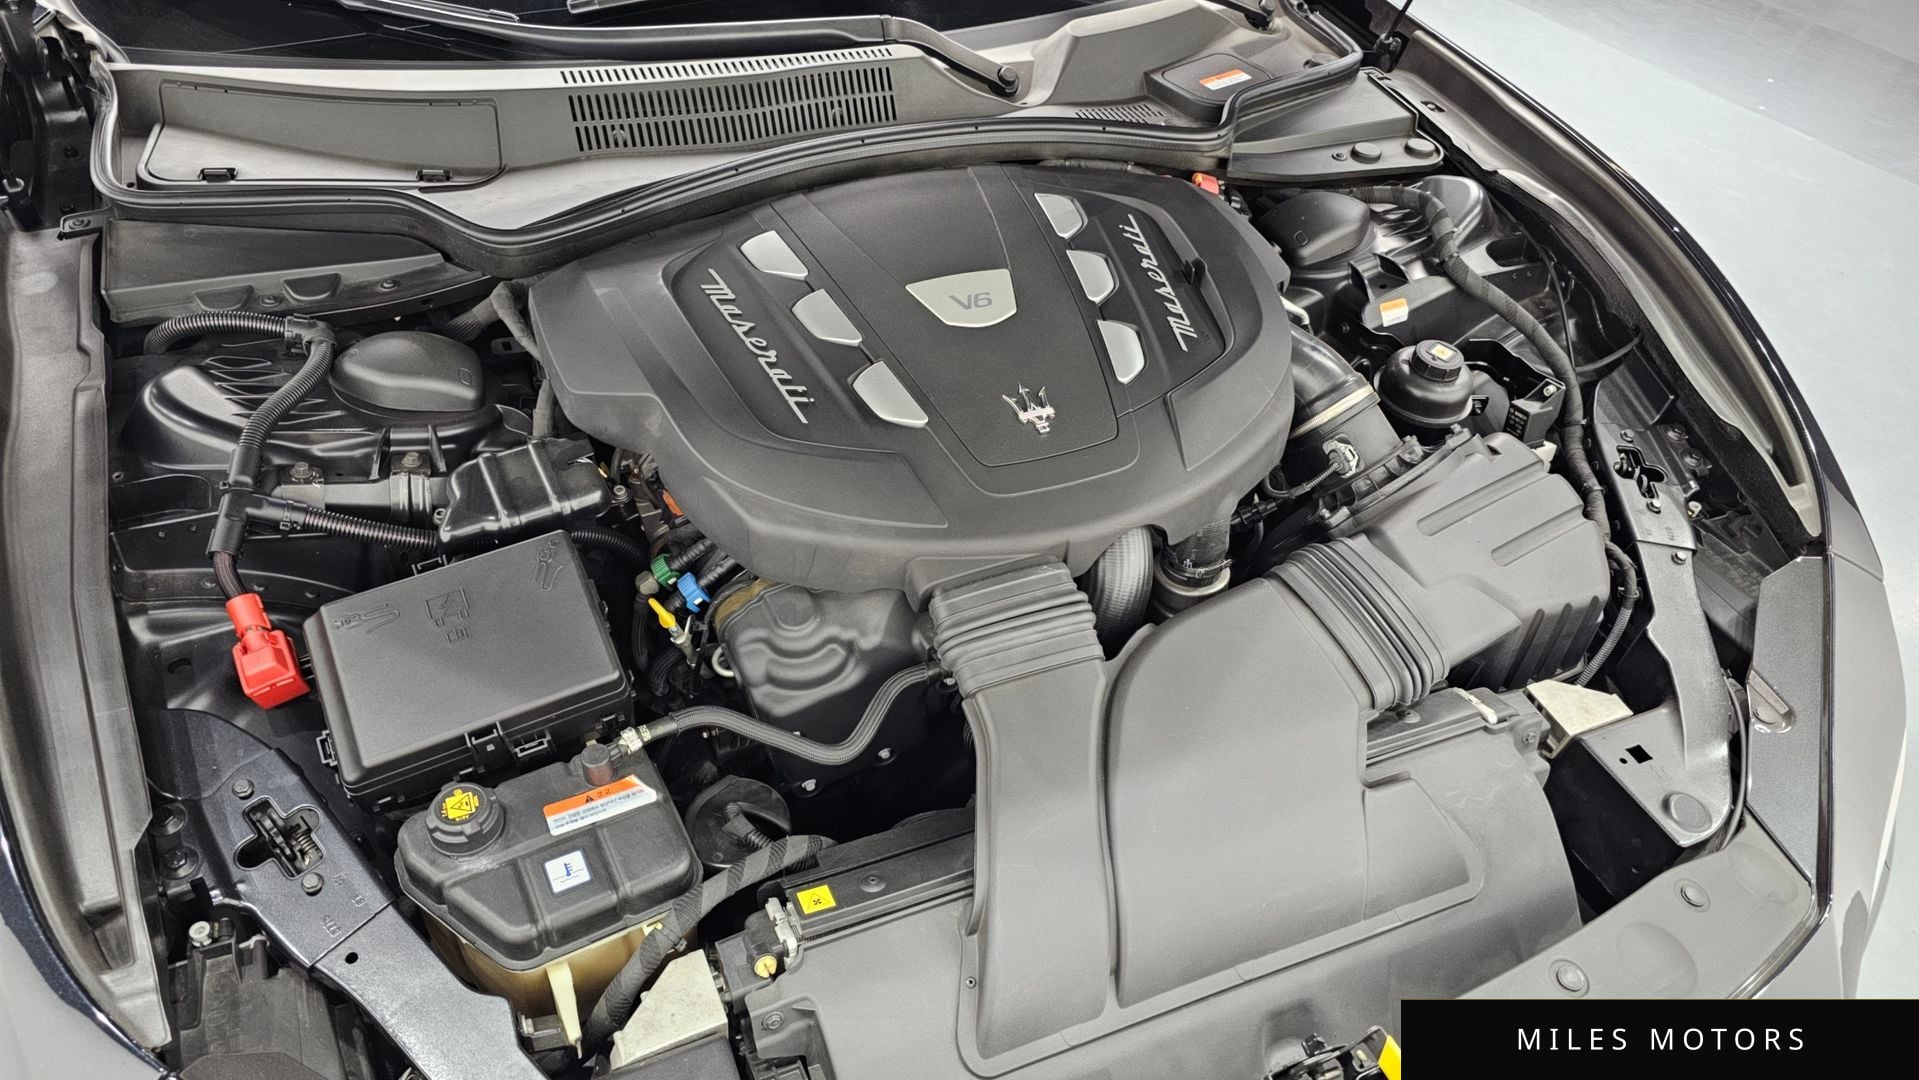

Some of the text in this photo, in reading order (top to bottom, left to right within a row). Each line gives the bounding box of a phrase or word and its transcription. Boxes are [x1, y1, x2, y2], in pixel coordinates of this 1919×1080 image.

[701, 268, 815, 424] Maserati
[948, 292, 992, 310] V6
[1119, 214, 1198, 352] Maserati
